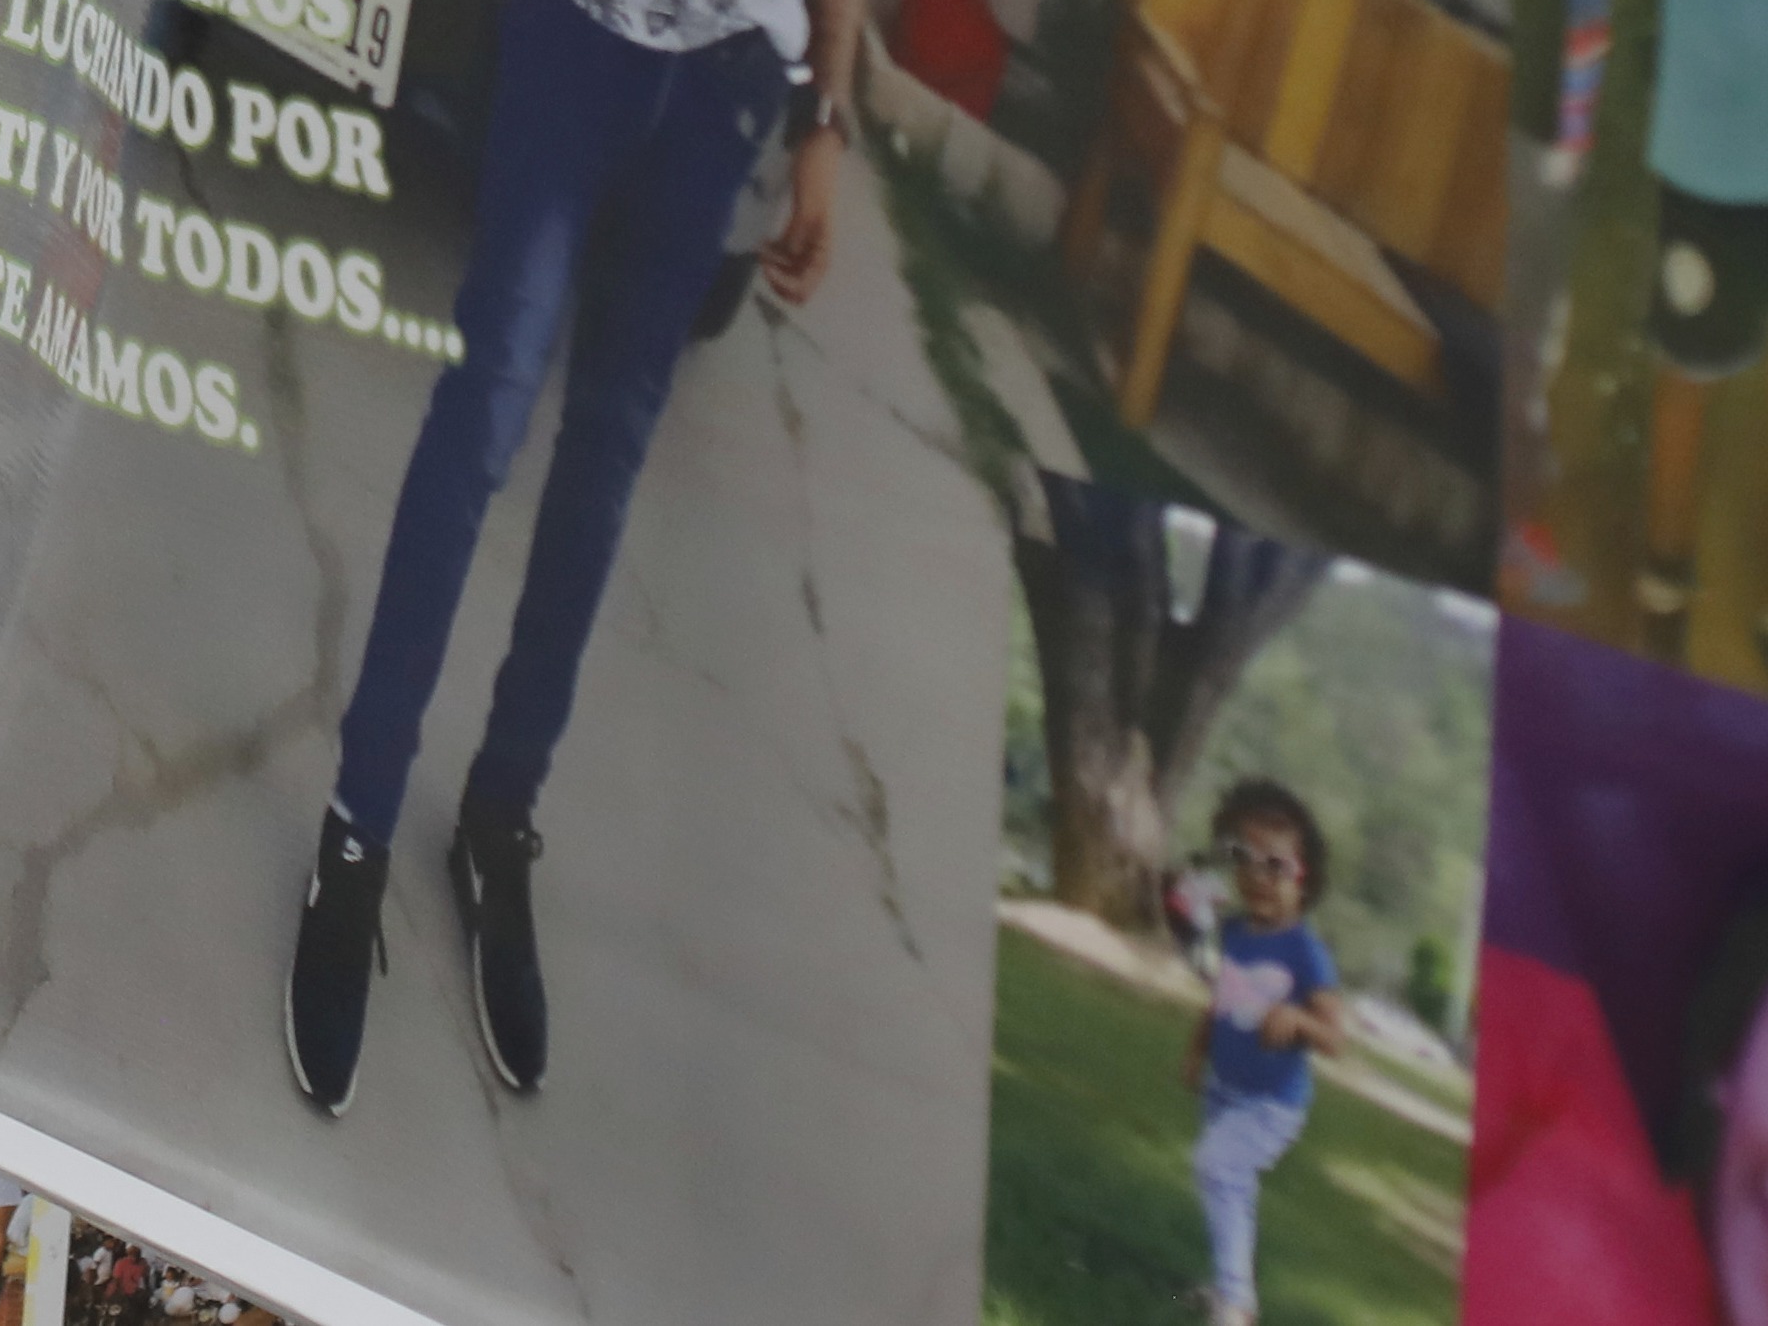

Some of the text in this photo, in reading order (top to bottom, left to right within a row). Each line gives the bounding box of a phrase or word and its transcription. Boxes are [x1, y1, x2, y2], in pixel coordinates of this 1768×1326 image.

[51, 128, 77, 208] Y
[75, 156, 123, 259] POR
[228, 84, 390, 196] POR
[30, 286, 260, 449] AMAMOS.
